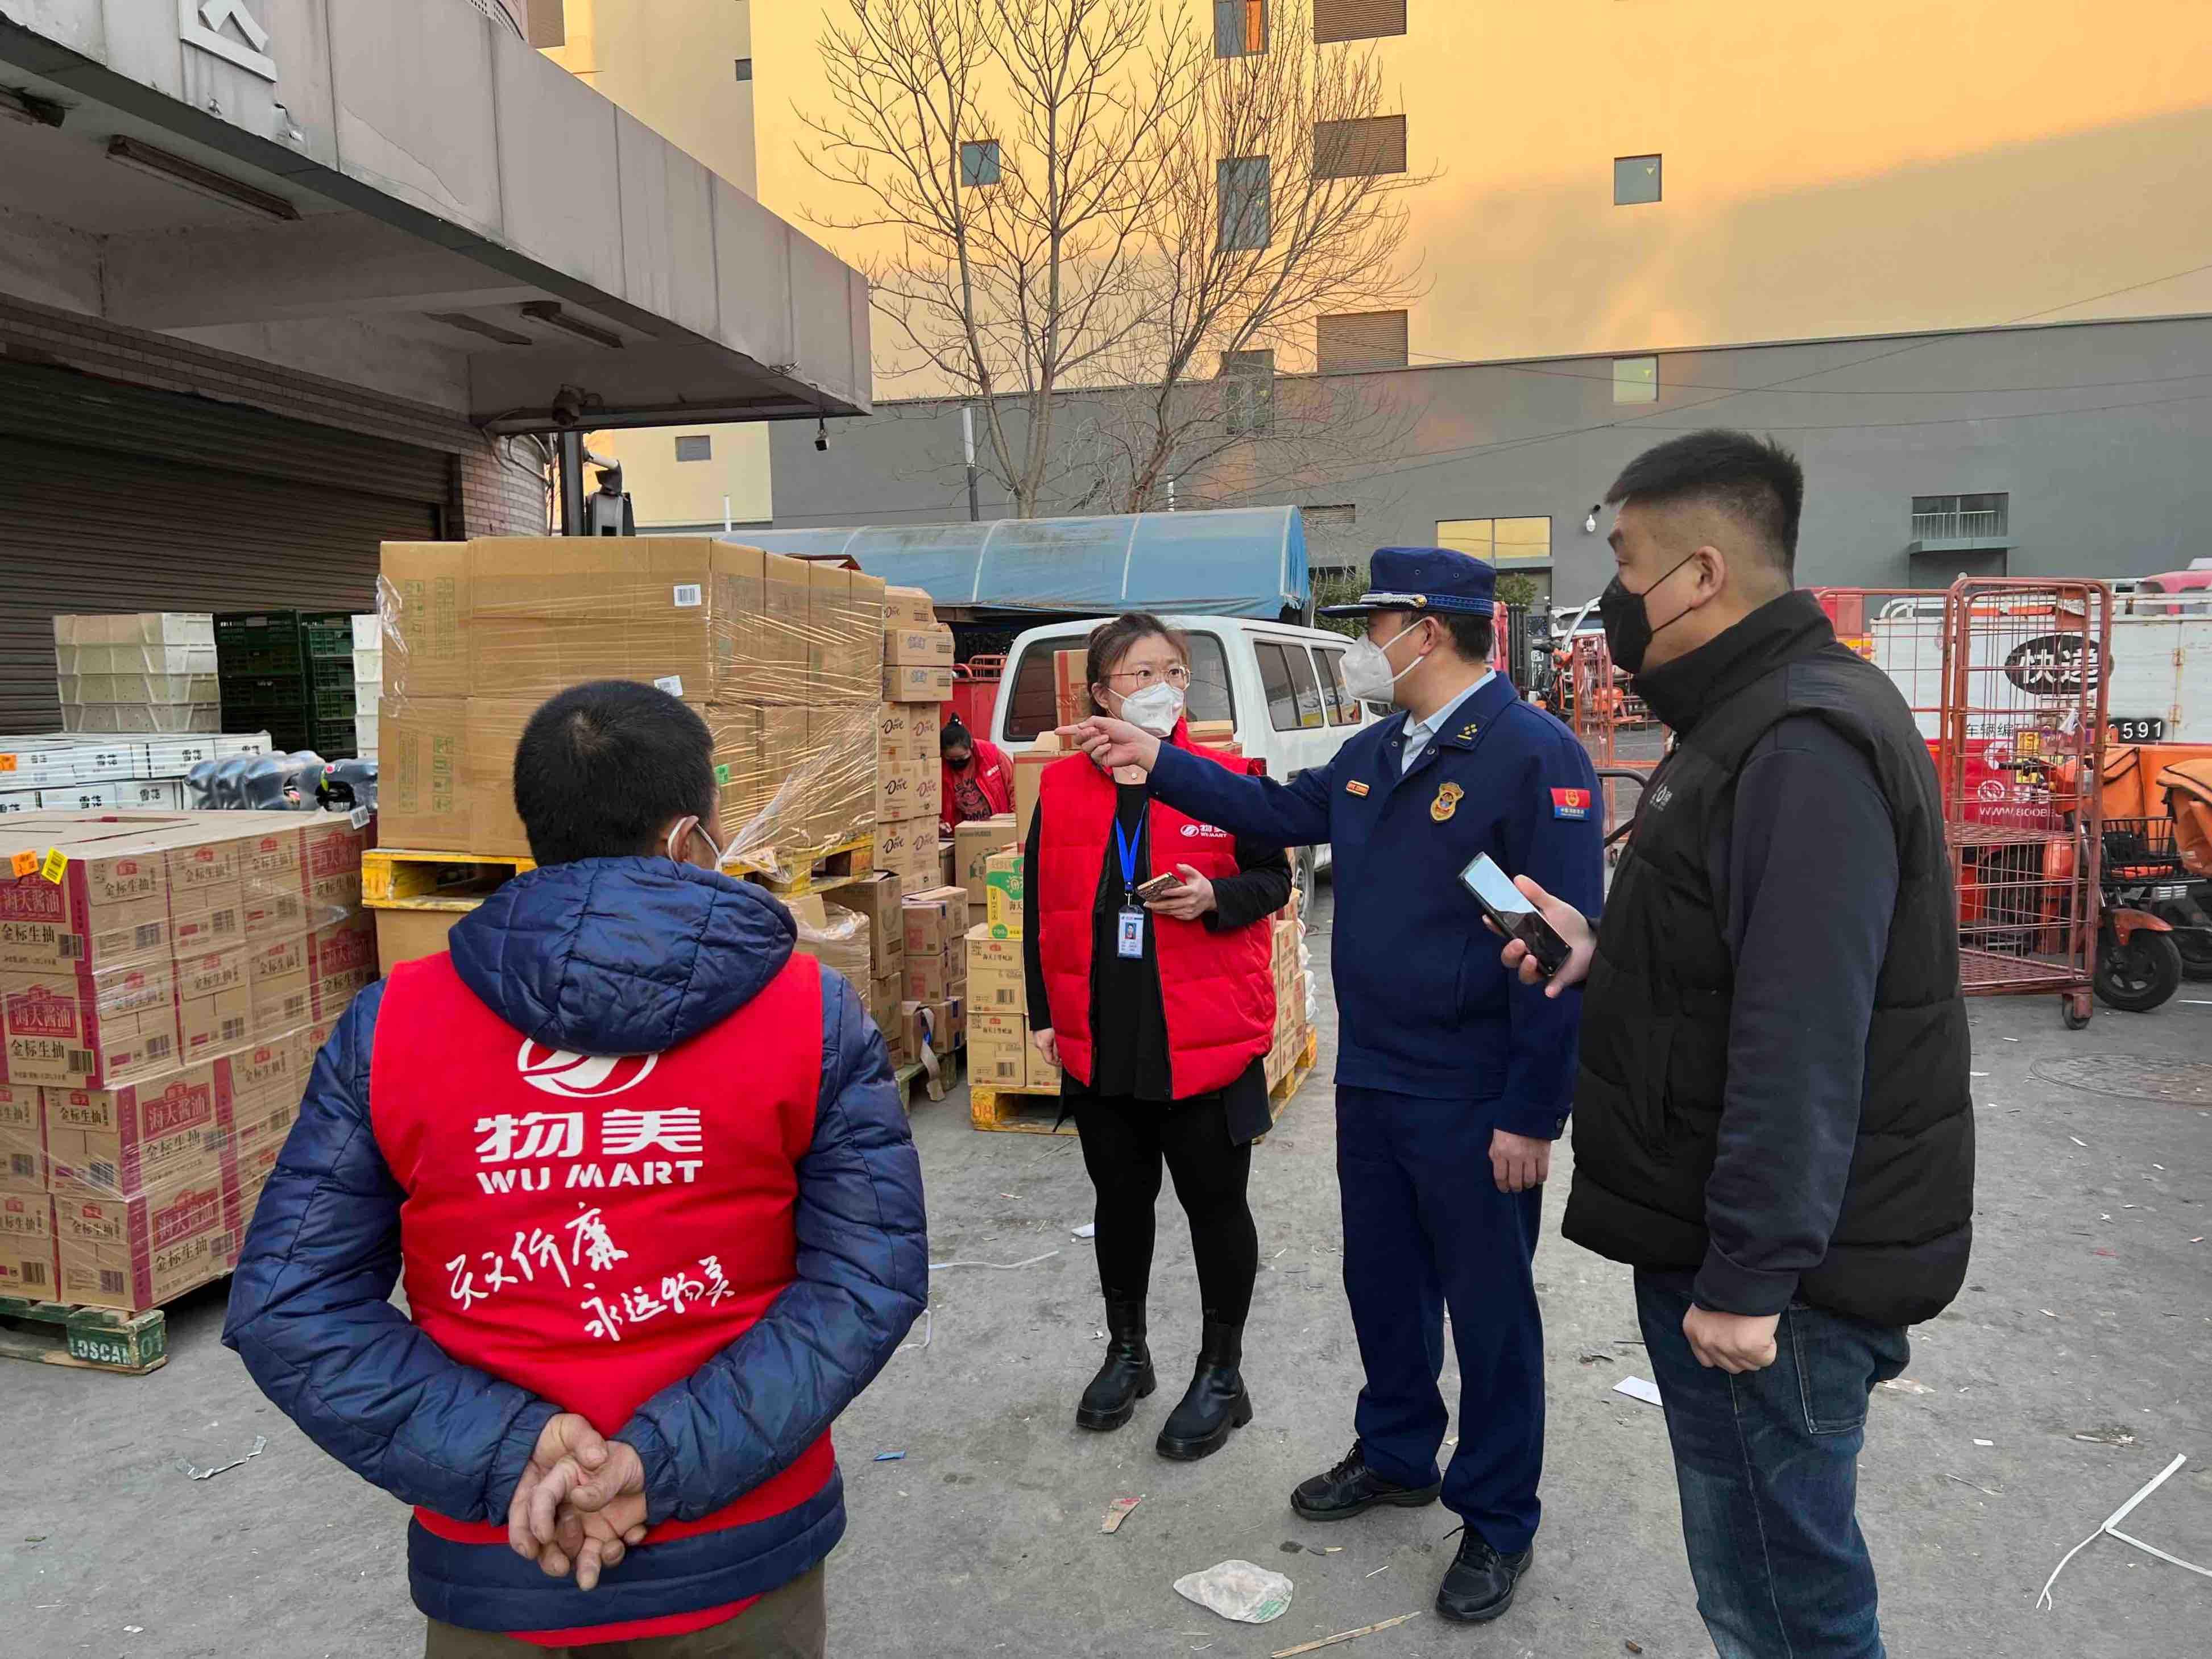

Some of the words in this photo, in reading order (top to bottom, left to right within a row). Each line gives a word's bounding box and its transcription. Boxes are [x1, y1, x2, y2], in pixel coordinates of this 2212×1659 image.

[105, 880, 150, 897] 金标生抽
[1, 922, 56, 943] 金标生抽
[14, 1003, 72, 1028] 海天酱油
[10, 1039, 65, 1059] 金标生抽
[60, 1107, 102, 1124] 金标生抽
[148, 1093, 206, 1131] 海天酱油
[147, 1129, 201, 1160] 金标生抽
[474, 1107, 703, 1163] 物美
[476, 1168, 551, 1195] WU
[565, 1160, 704, 1189] MART
[156, 1236, 208, 1272] 金标生抽
